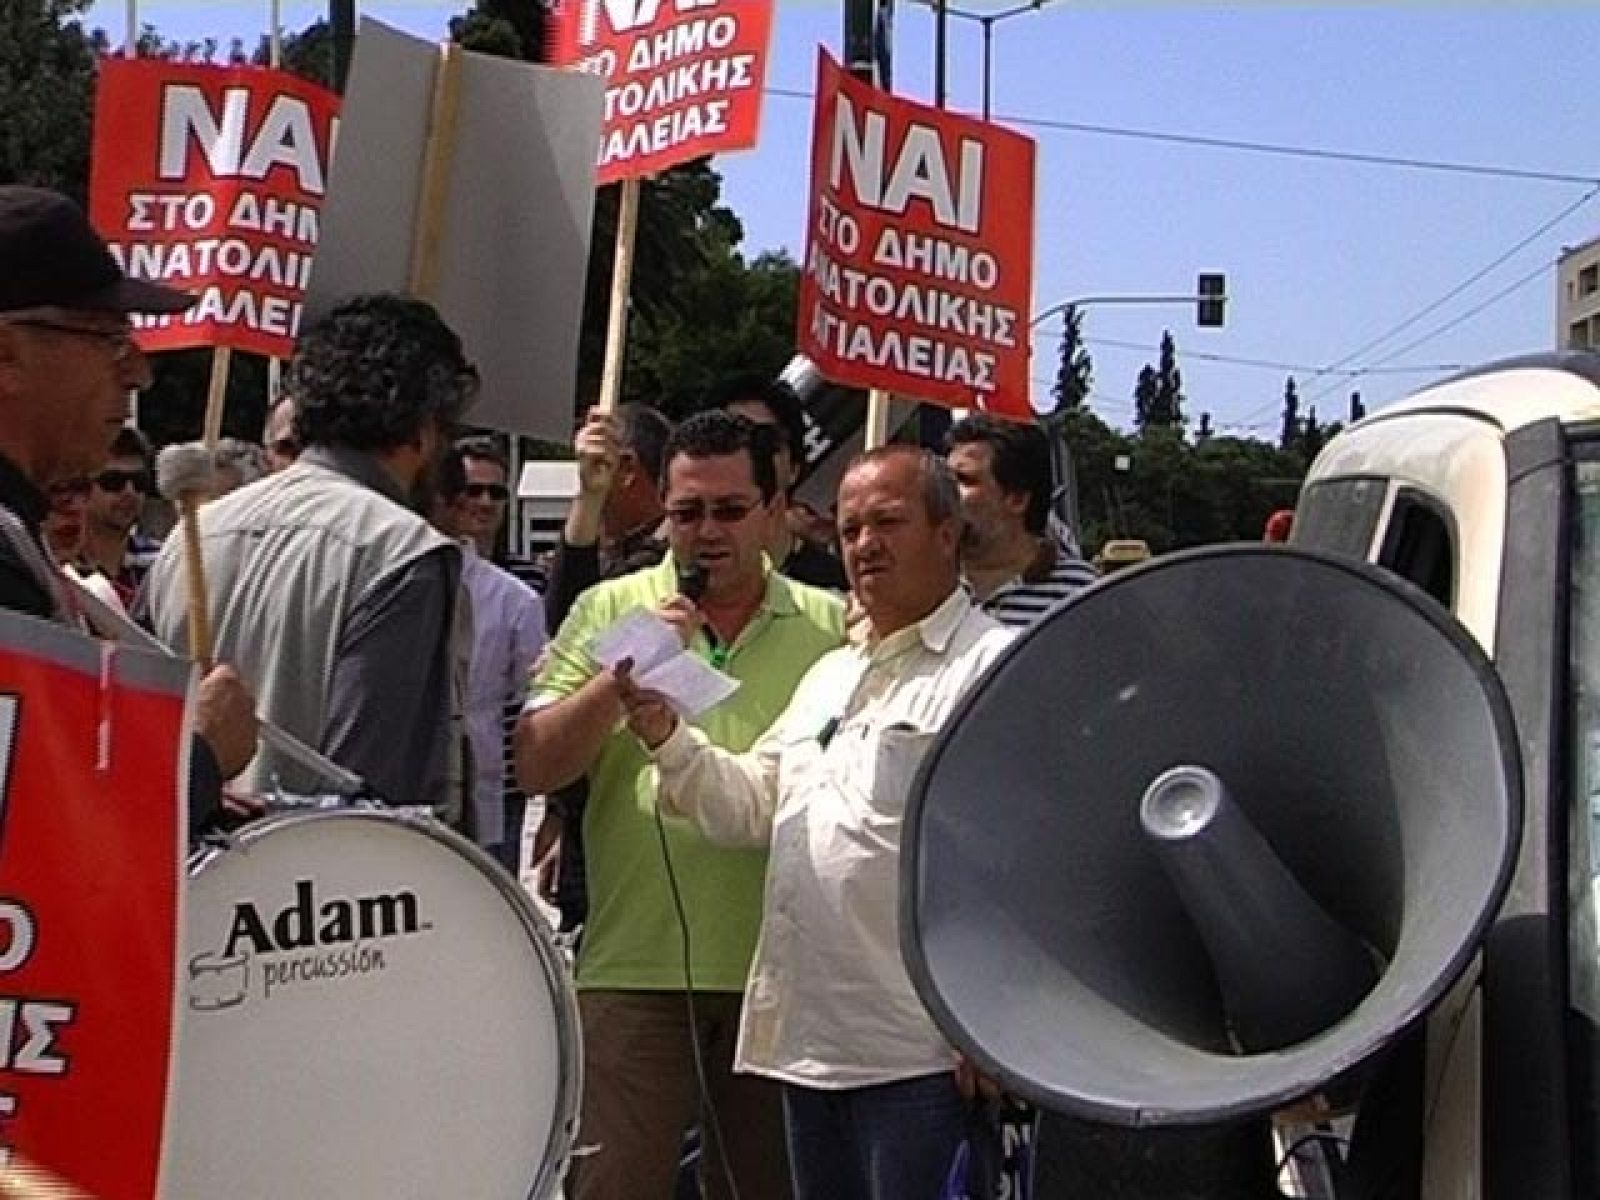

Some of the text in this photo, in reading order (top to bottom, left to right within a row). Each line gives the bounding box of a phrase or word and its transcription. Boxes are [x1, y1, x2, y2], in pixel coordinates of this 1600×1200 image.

[627, 15, 736, 73] ΔΗΜΟ
[604, 54, 755, 121] ΤΟΛΙΚΗΣ
[830, 92, 984, 233] ΝΑΙ
[127, 192, 319, 244] ΣΤΟ ΔΗΜ
[874, 228, 998, 289] ΔΗΜΟ
[223, 879, 418, 958] Adam
[262, 942, 385, 998] percussion
